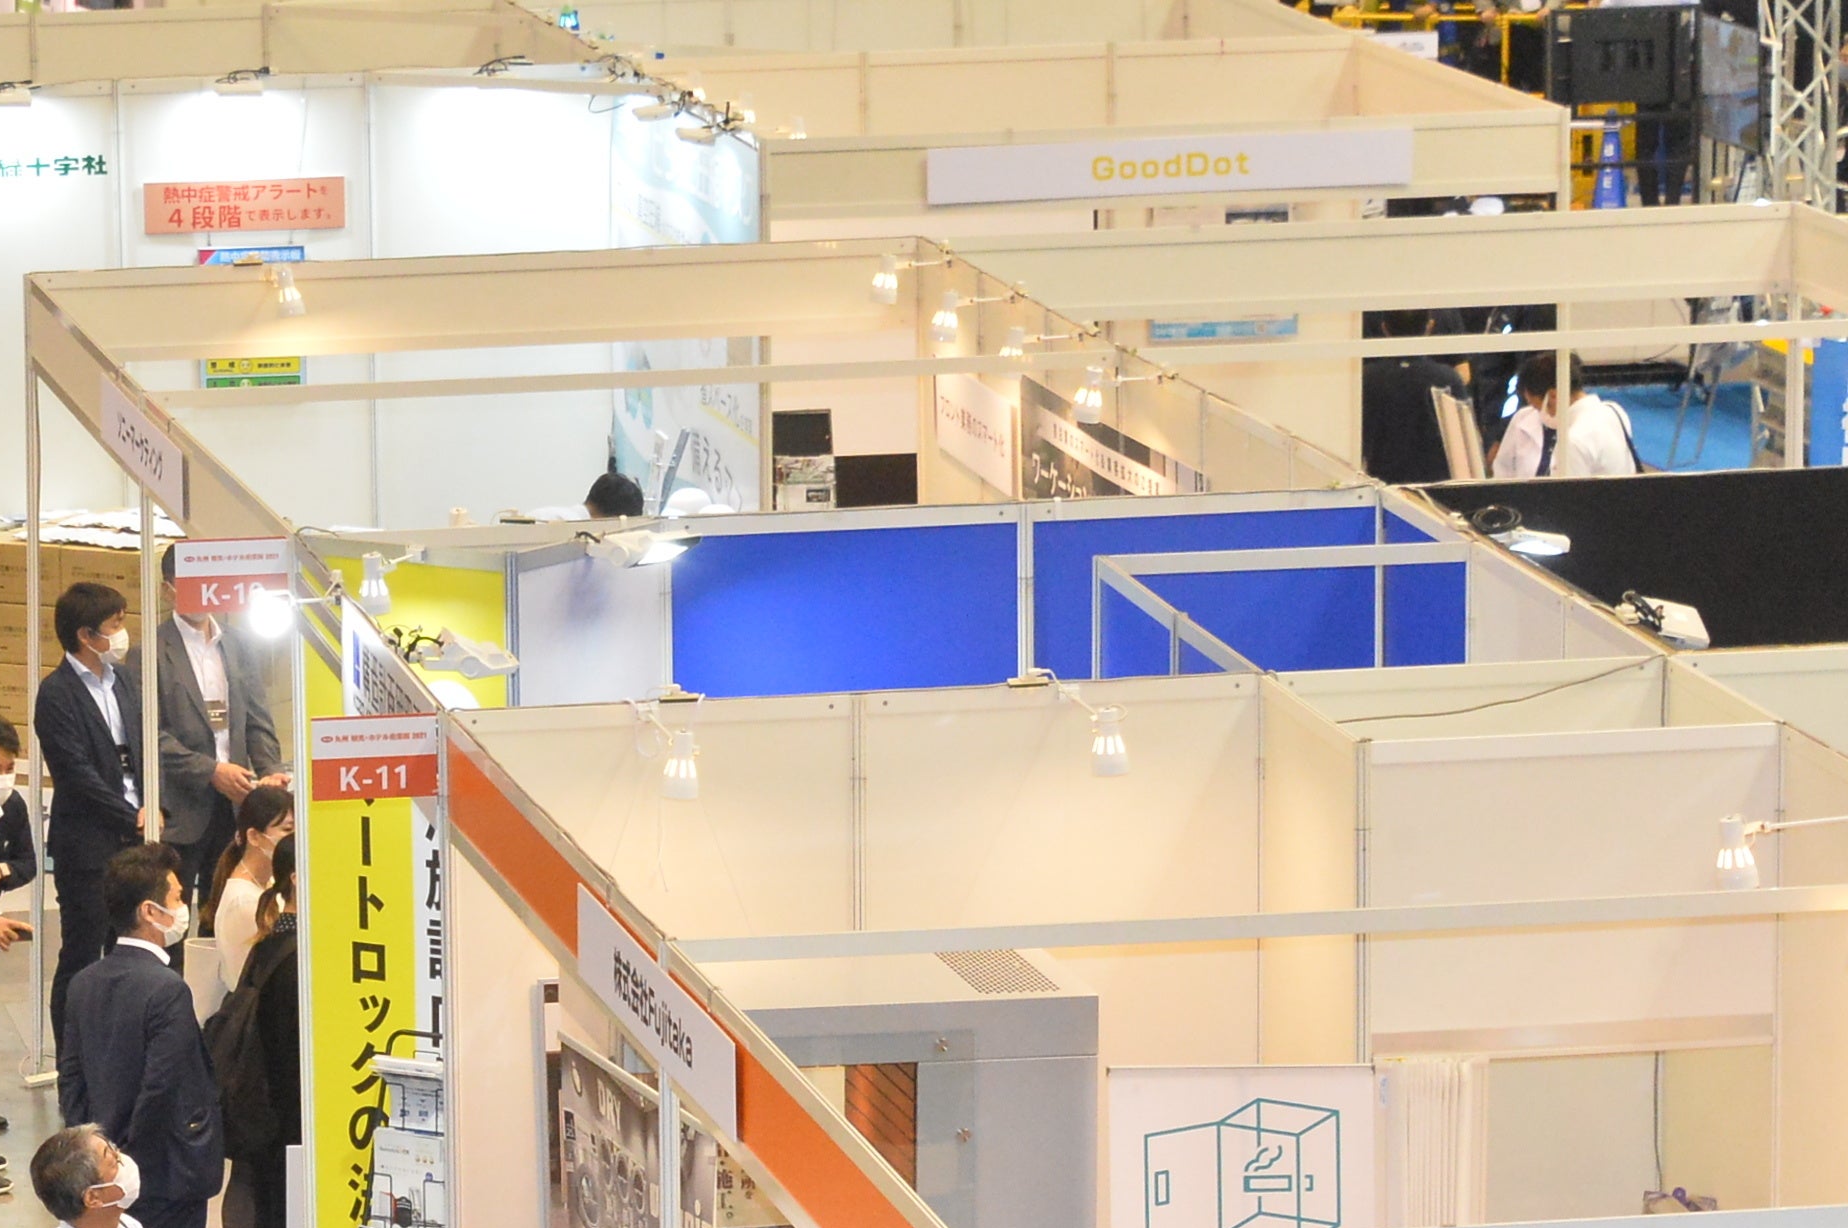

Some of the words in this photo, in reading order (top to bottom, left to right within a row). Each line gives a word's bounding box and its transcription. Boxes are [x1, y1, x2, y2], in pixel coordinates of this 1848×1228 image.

[1092, 151, 1250, 182] GoodDot
[163, 183, 328, 204] 熱中症警戒アラートを
[202, 582, 264, 606] K-1
[339, 764, 407, 792] K-11
[613, 947, 693, 1069] 株式会社Fujitaka
